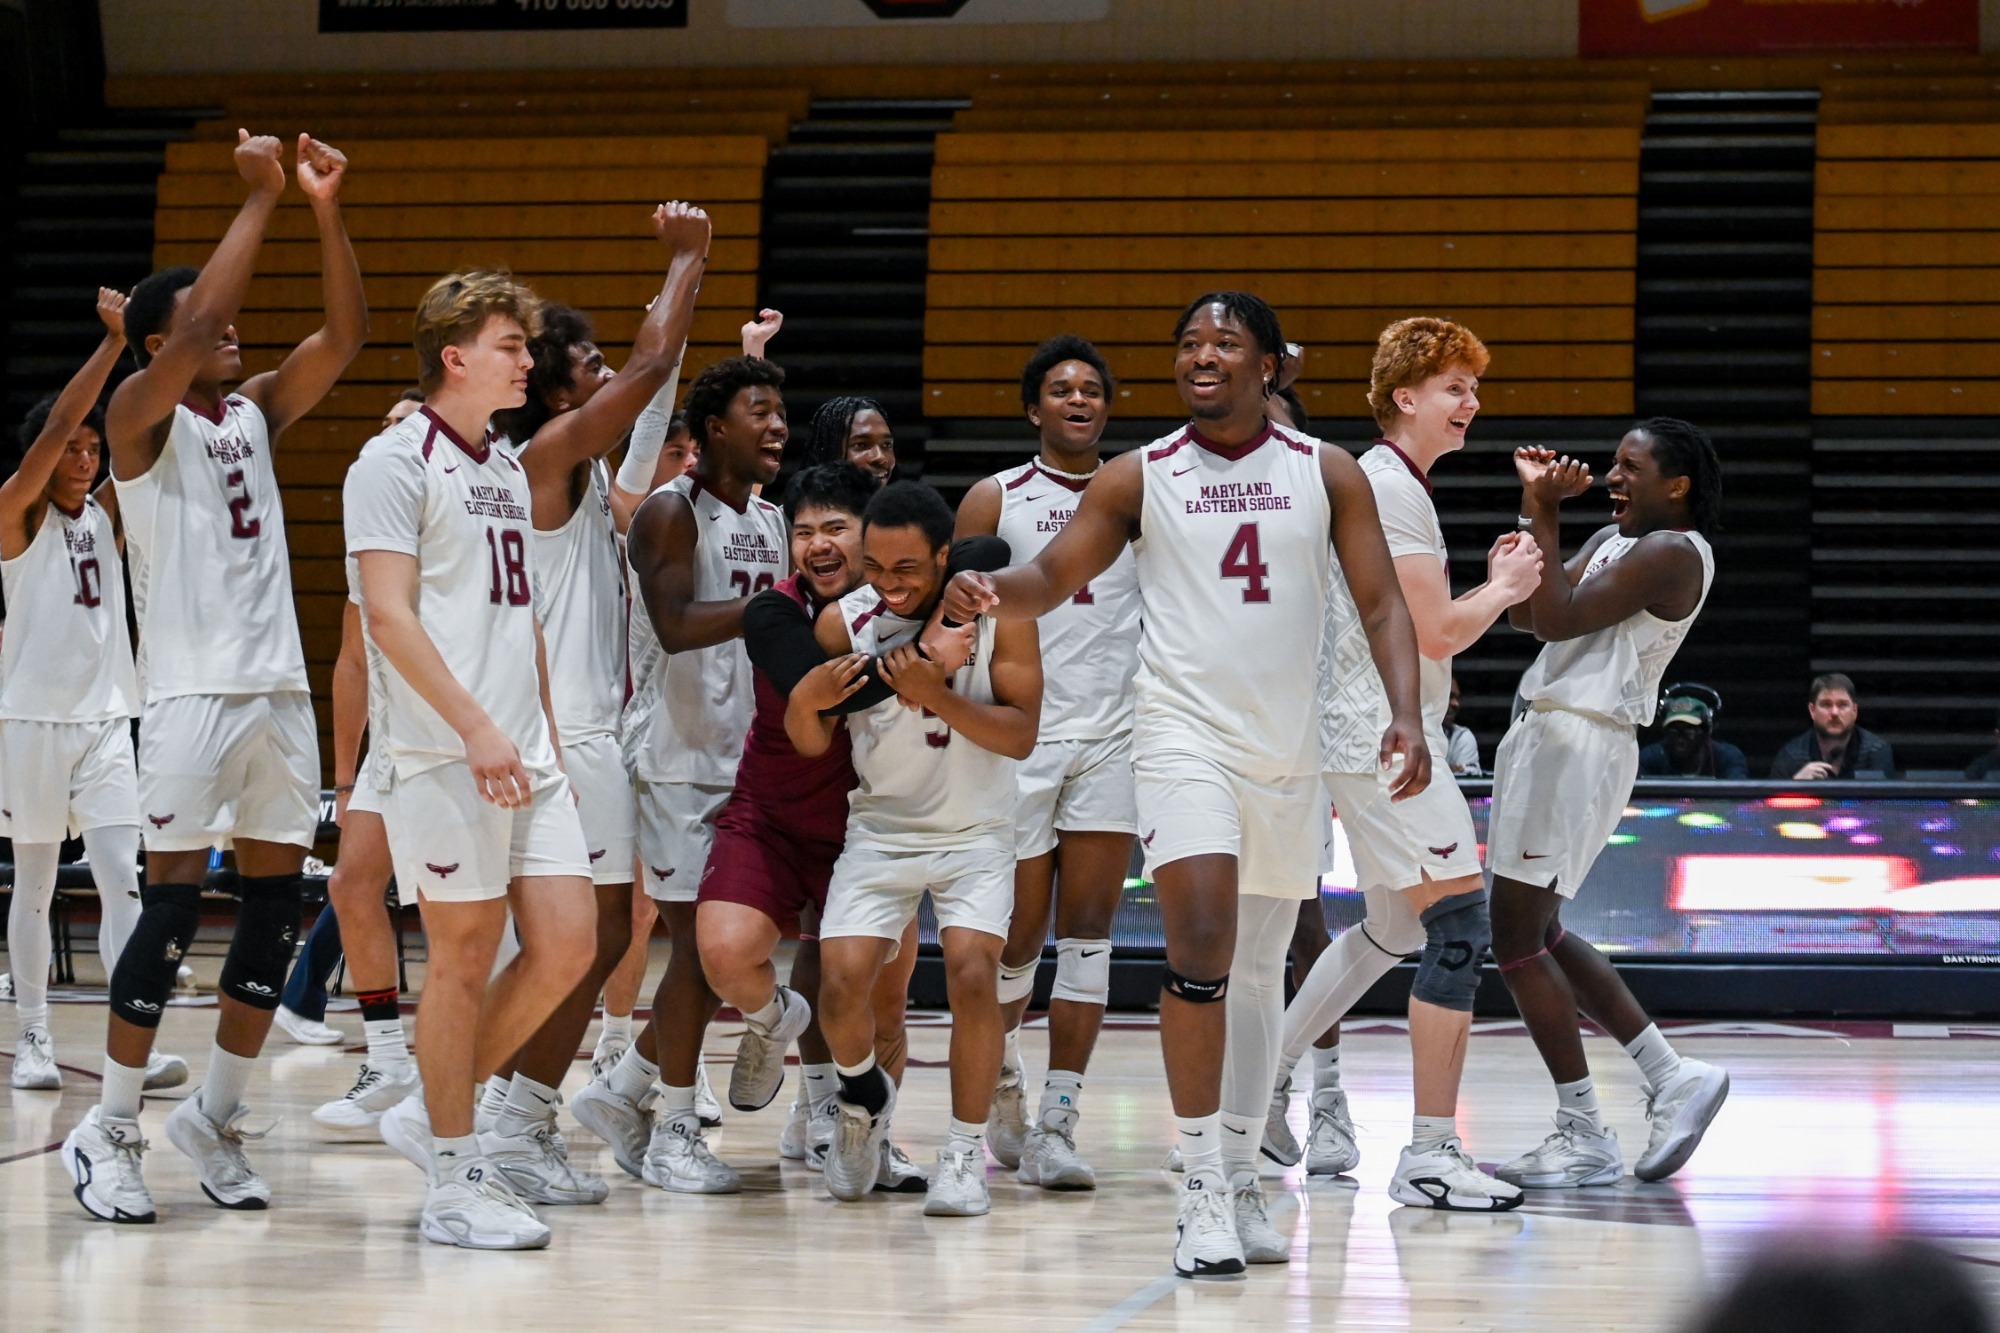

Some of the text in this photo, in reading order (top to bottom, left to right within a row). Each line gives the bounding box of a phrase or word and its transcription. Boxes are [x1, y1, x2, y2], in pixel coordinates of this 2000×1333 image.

[469, 485, 515, 503] MARYLAND
[1200, 482, 1272, 499] MARYLAND
[226, 468, 260, 539] 2
[464, 500, 528, 521] EASTERN SHORE
[1185, 496, 1292, 514] EASTERN SHORE
[1036, 521, 1067, 532] EAST
[723, 546, 780, 564] EASTERN SHORE
[1219, 521, 1271, 604] 4
[486, 525, 532, 607] 18
